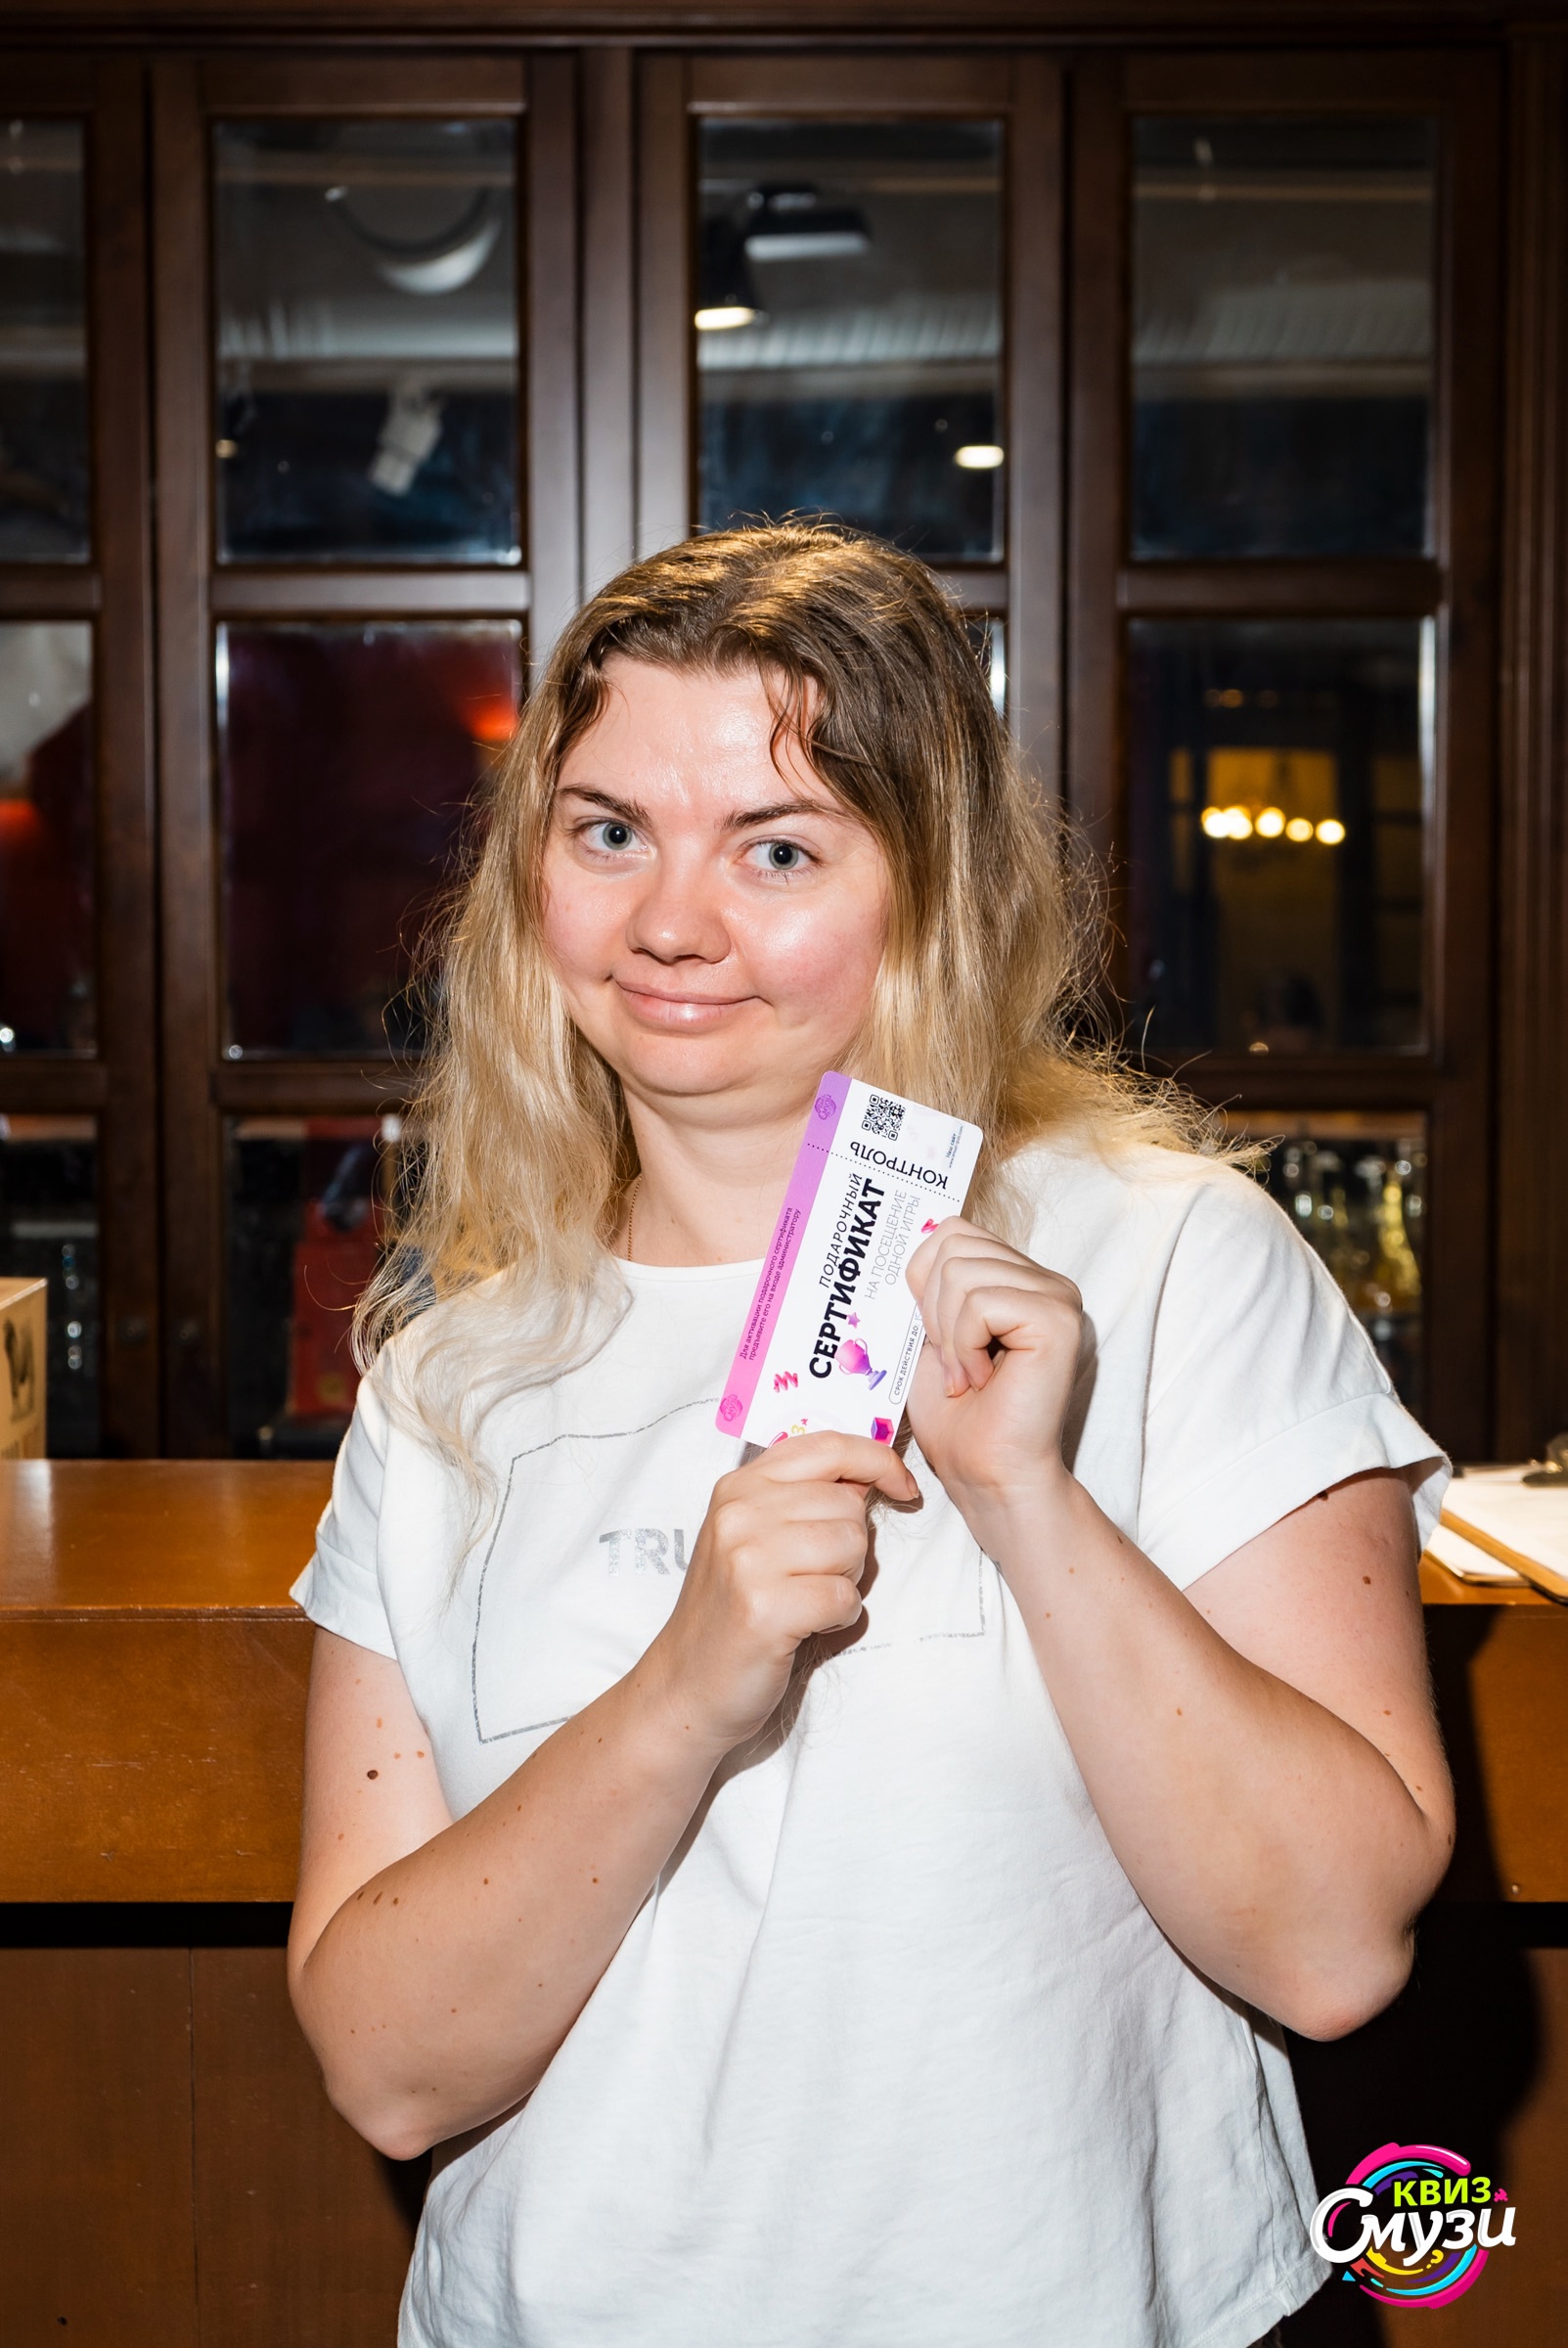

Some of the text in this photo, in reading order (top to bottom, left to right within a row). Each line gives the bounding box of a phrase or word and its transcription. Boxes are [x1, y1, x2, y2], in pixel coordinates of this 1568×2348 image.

[850, 1141, 948, 1190] КОНТРОЛЬ
[778, 1208, 801, 1270] администратору
[819, 1173, 863, 1288] ПОДАРОЧНЫЙ
[864, 1190, 907, 1299] НА ПОСЕЩЕНИЕ
[884, 1196, 920, 1286] ОДНОЙ ИГРЫ
[739, 1207, 792, 1360] Для активации подарочного сертификата
[767, 1293, 774, 1302] на
[770, 1271, 781, 1292] входе
[809, 1178, 884, 1378] СЕРТИФИКАТ
[748, 1317, 767, 1361] предъявите
[894, 1377, 904, 1396] СРОК
[900, 1337, 915, 1376] ДЕЙСТВИЯ
